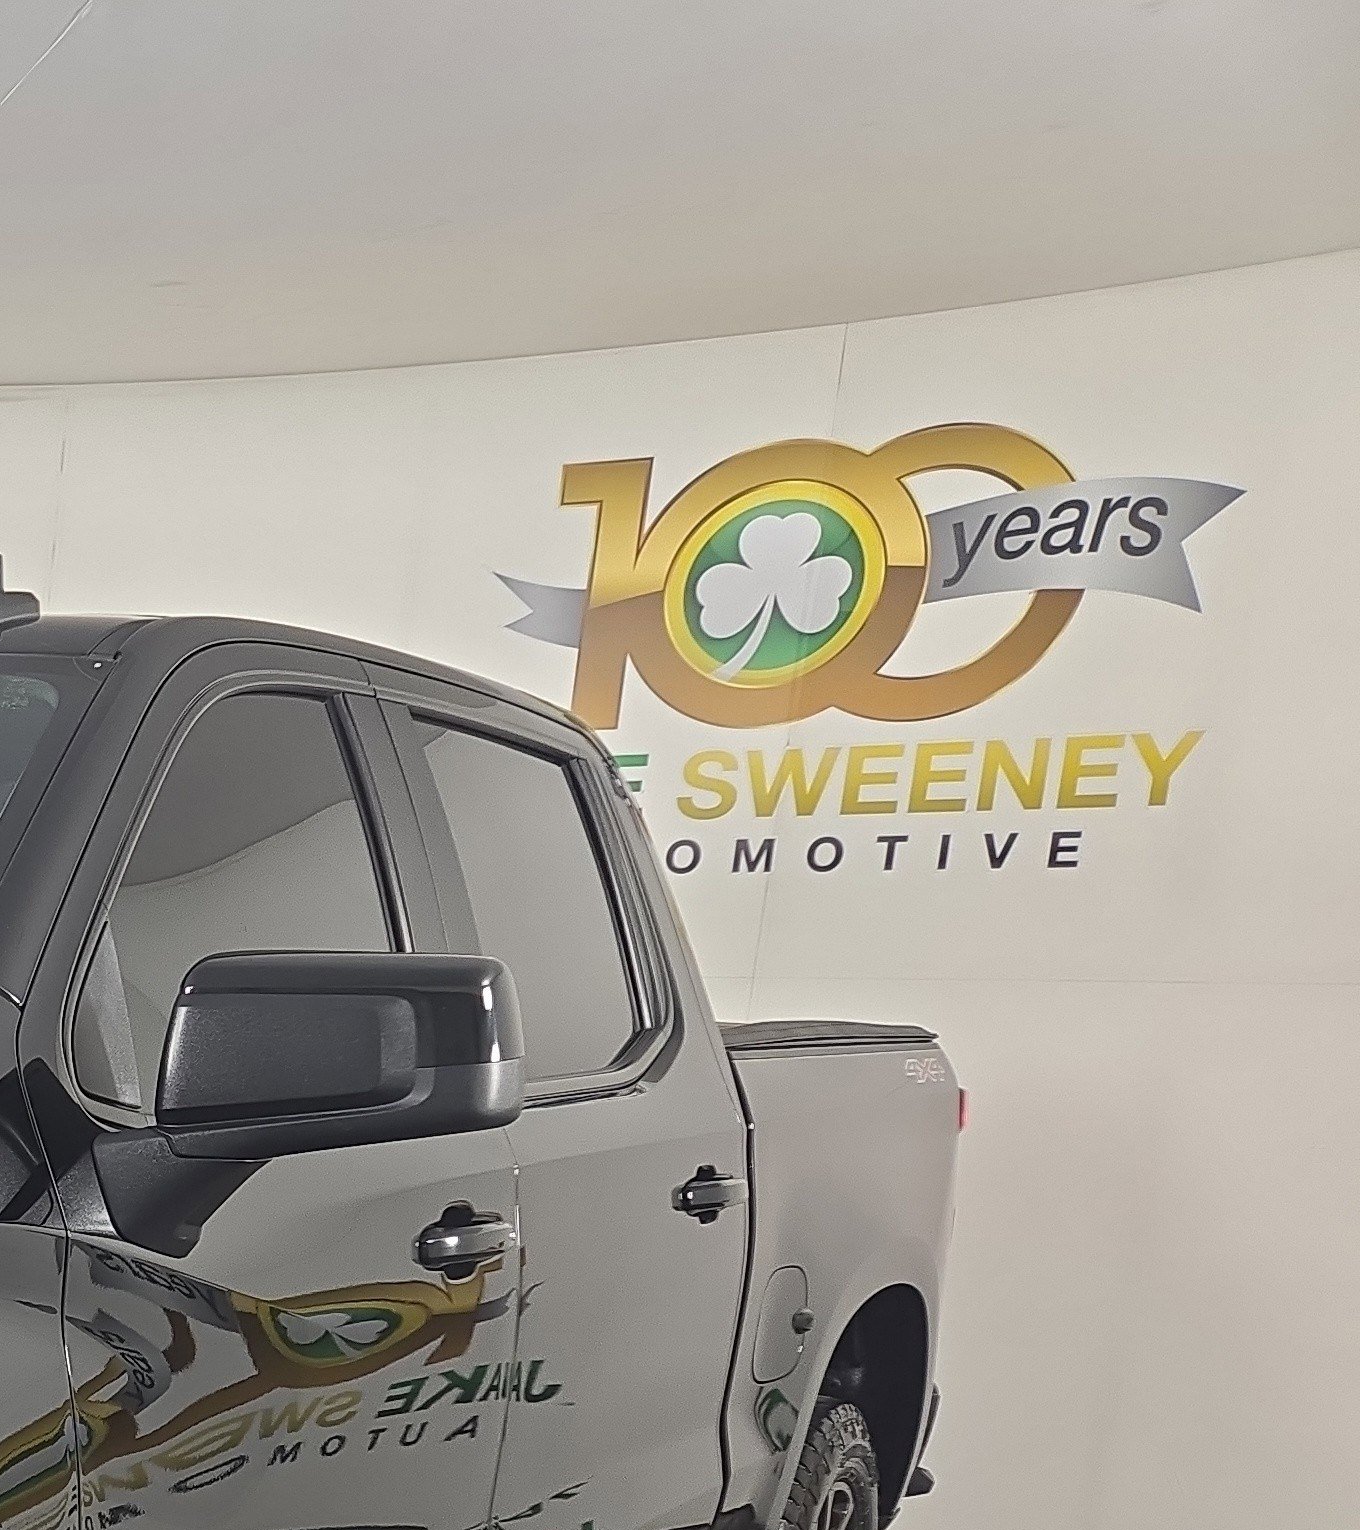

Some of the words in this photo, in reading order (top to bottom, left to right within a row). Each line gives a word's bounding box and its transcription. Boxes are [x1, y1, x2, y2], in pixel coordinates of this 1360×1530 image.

[561, 422, 1085, 730] 100
[942, 495, 1169, 588] years
[676, 730, 1205, 820] SWEENEY
[666, 829, 1083, 874] OMOTIVE
